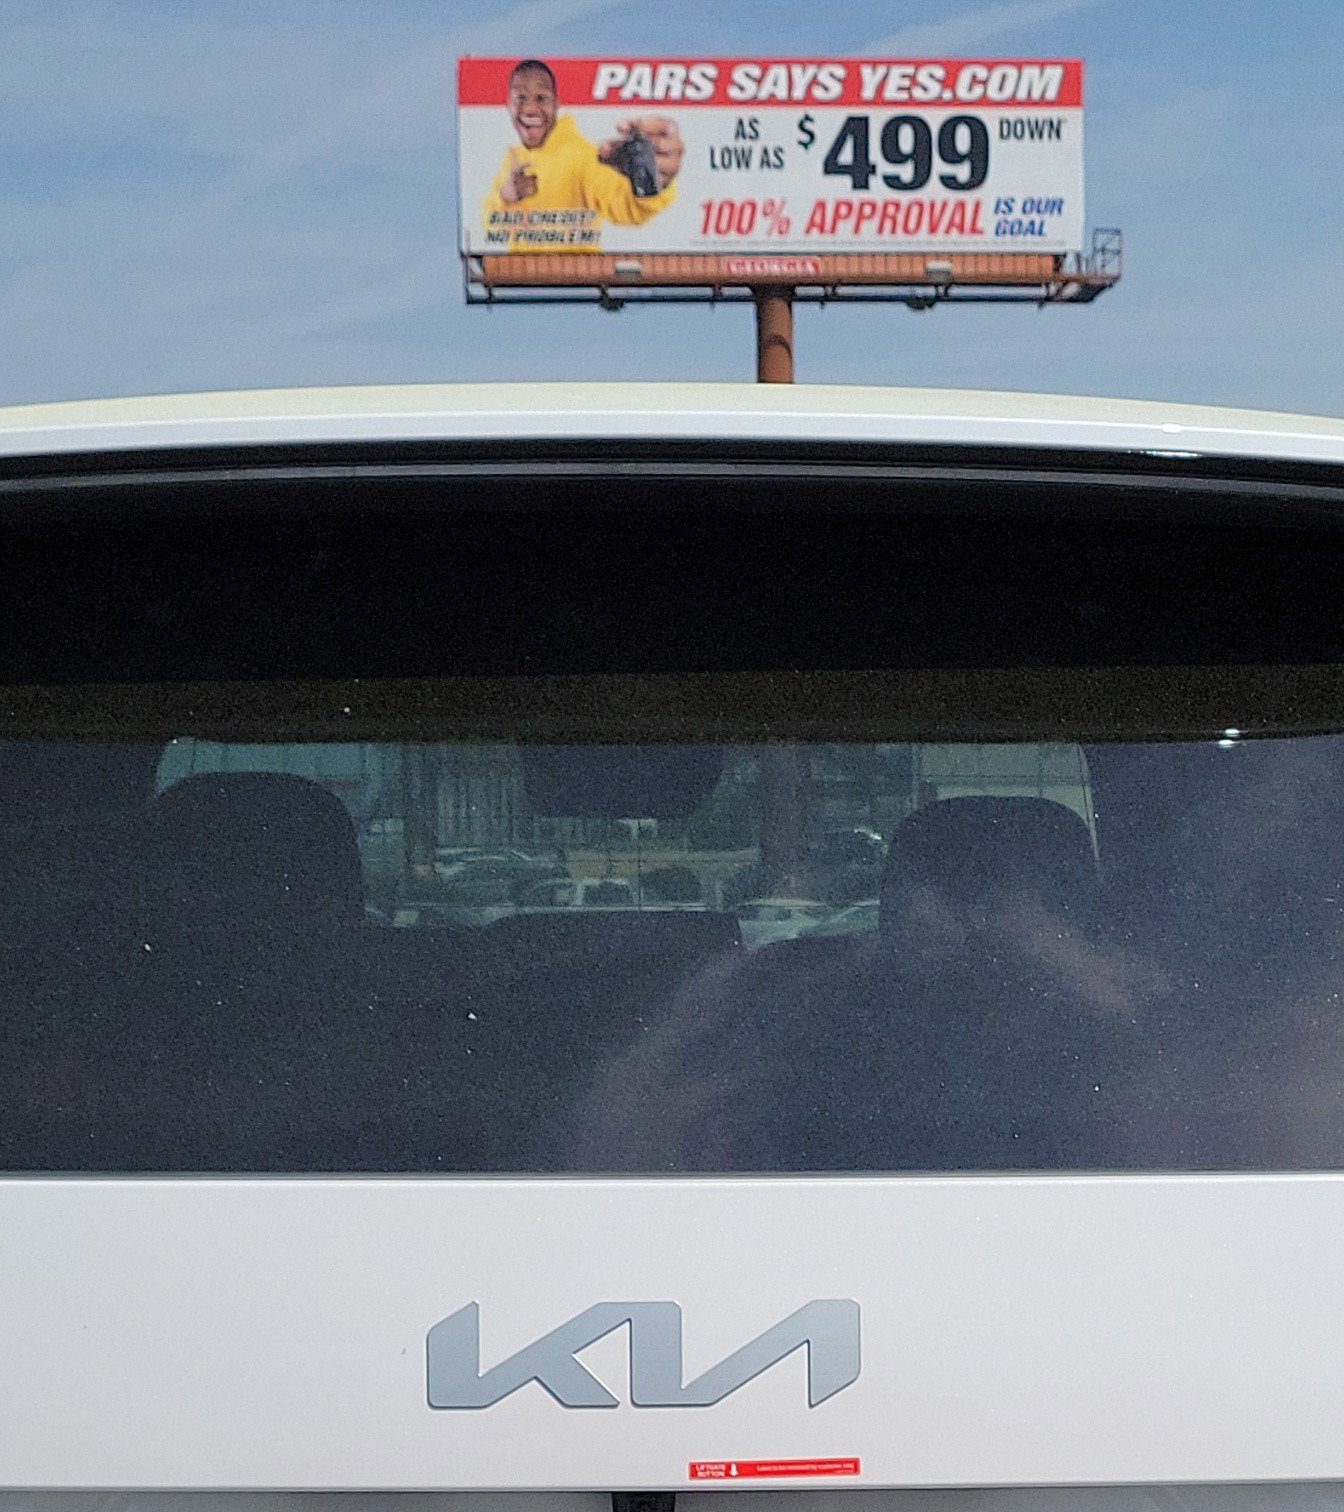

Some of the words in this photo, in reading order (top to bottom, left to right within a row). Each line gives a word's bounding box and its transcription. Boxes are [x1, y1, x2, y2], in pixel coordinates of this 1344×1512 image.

[592, 64, 718, 101] PARS
[727, 64, 845, 101] SAYS
[855, 65, 1064, 101] YES.COM
[735, 118, 760, 140] AS
[999, 118, 1062, 140] DOWN
[709, 147, 753, 170] LOW
[759, 147, 785, 169] AS
[994, 197, 1015, 214] IS
[1022, 198, 1065, 215] OUR
[700, 199, 791, 236] 100%
[804, 199, 985, 236] APPROVAL
[995, 218, 1047, 237] GOAL
[427, 1298, 861, 1409] KIA
